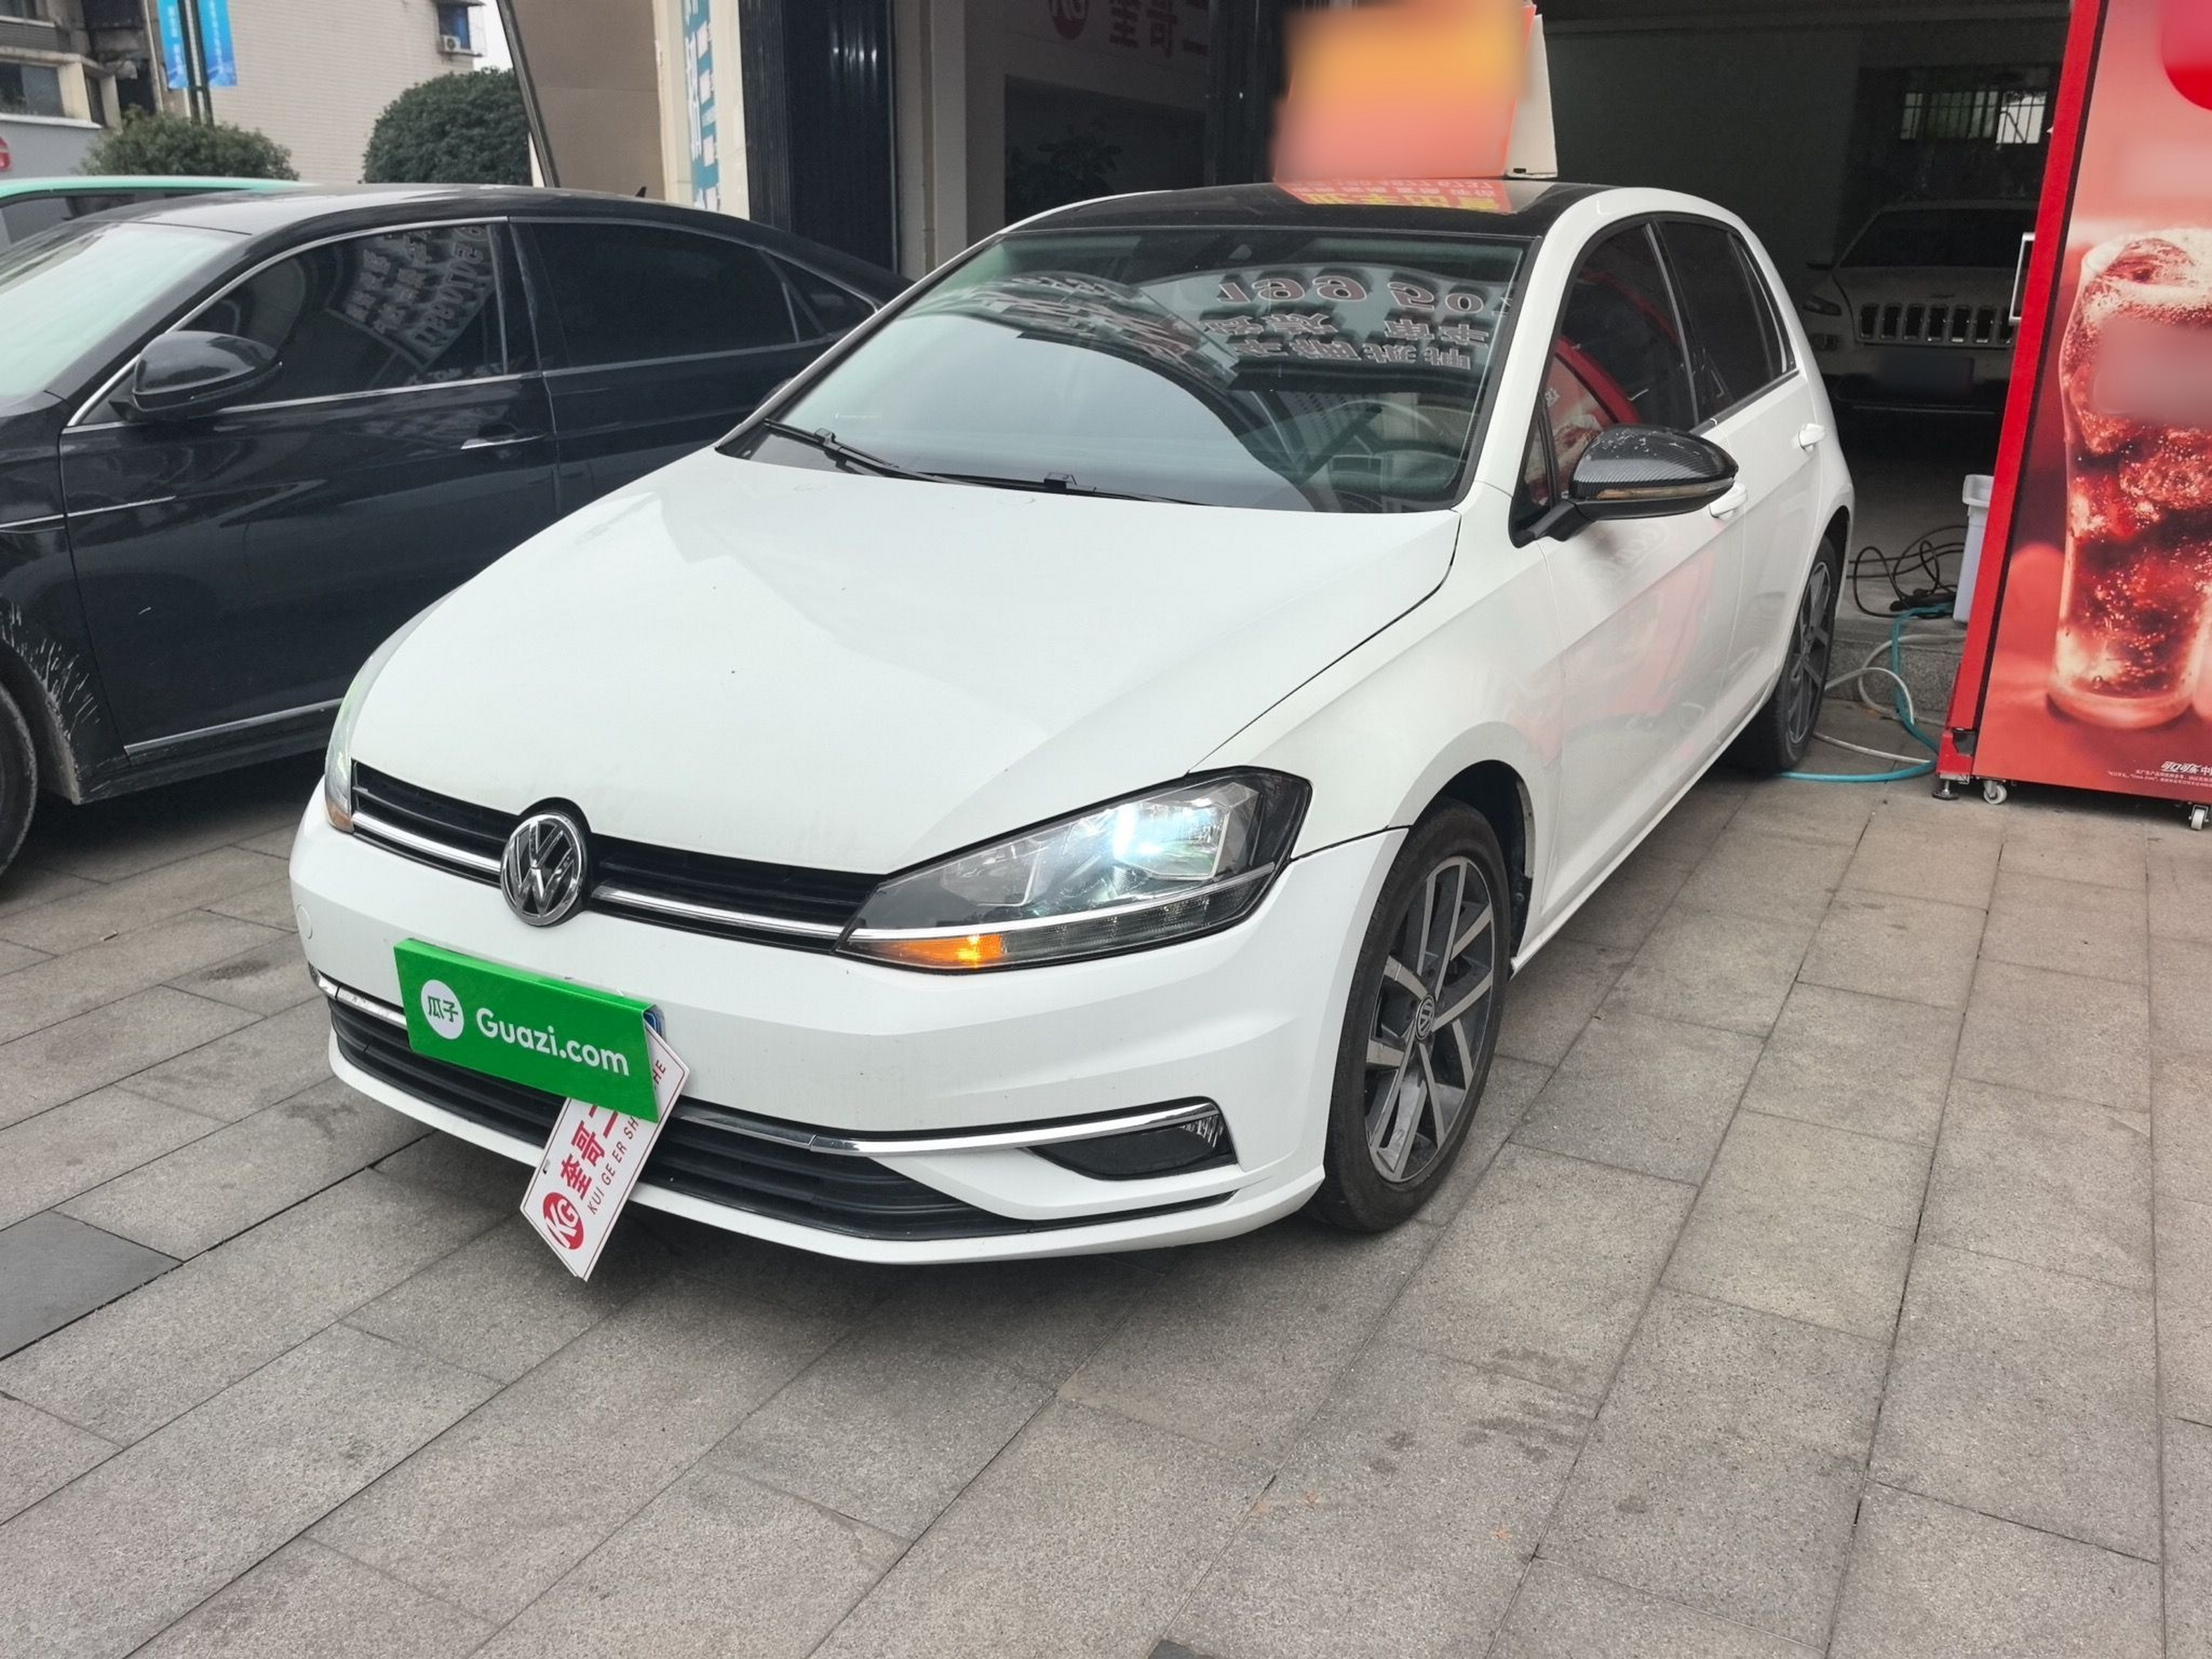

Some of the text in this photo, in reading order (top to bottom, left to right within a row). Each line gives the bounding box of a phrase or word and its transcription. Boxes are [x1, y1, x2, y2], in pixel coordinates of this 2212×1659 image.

[426, 995, 459, 1023] 瓜子
[475, 1007, 630, 1077] Guazi.com
[588, 1059, 666, 1215] KUI GE ER SH HE
